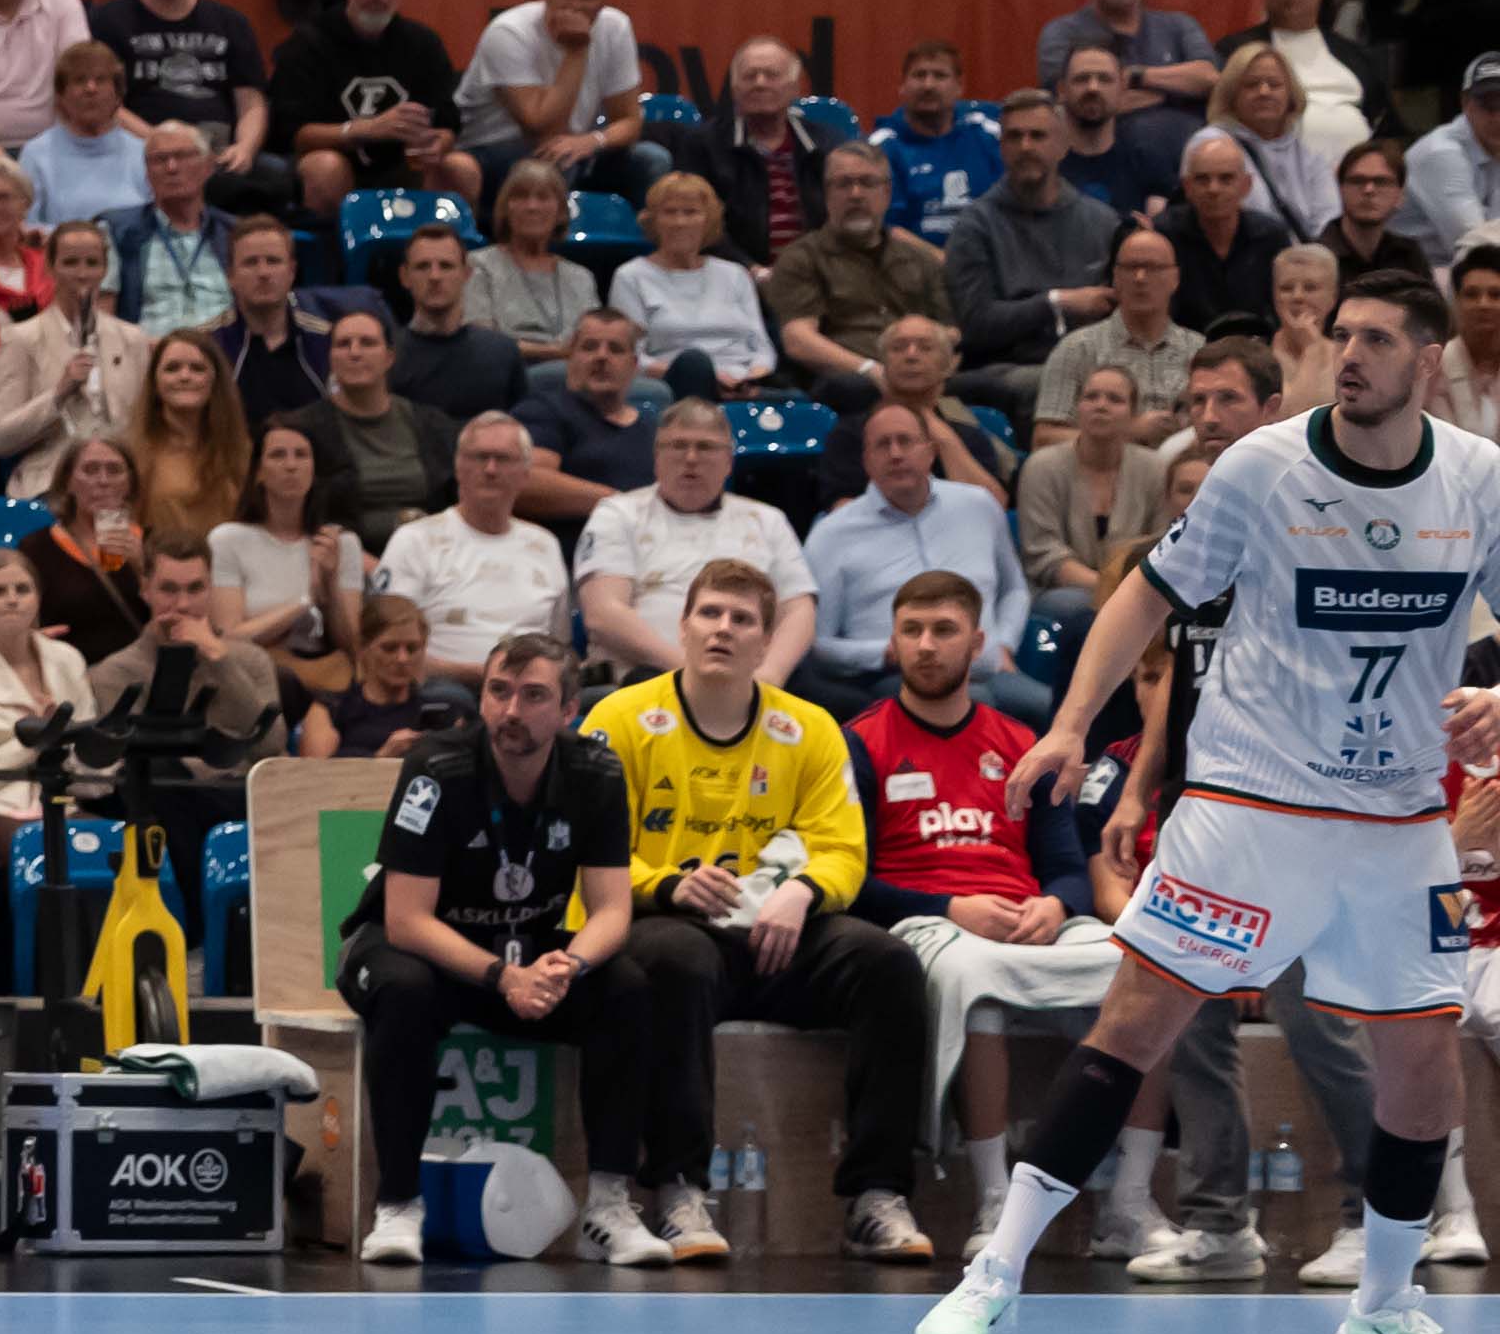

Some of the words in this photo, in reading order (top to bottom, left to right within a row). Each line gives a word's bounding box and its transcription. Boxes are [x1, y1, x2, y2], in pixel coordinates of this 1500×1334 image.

[1313, 585, 1449, 609] Buderus
[1348, 643, 1408, 704] 77
[918, 801, 994, 842] play
[1177, 935, 1252, 975] ENERGIE
[432, 1047, 538, 1122] A&J
[110, 1153, 188, 1187] AOK
